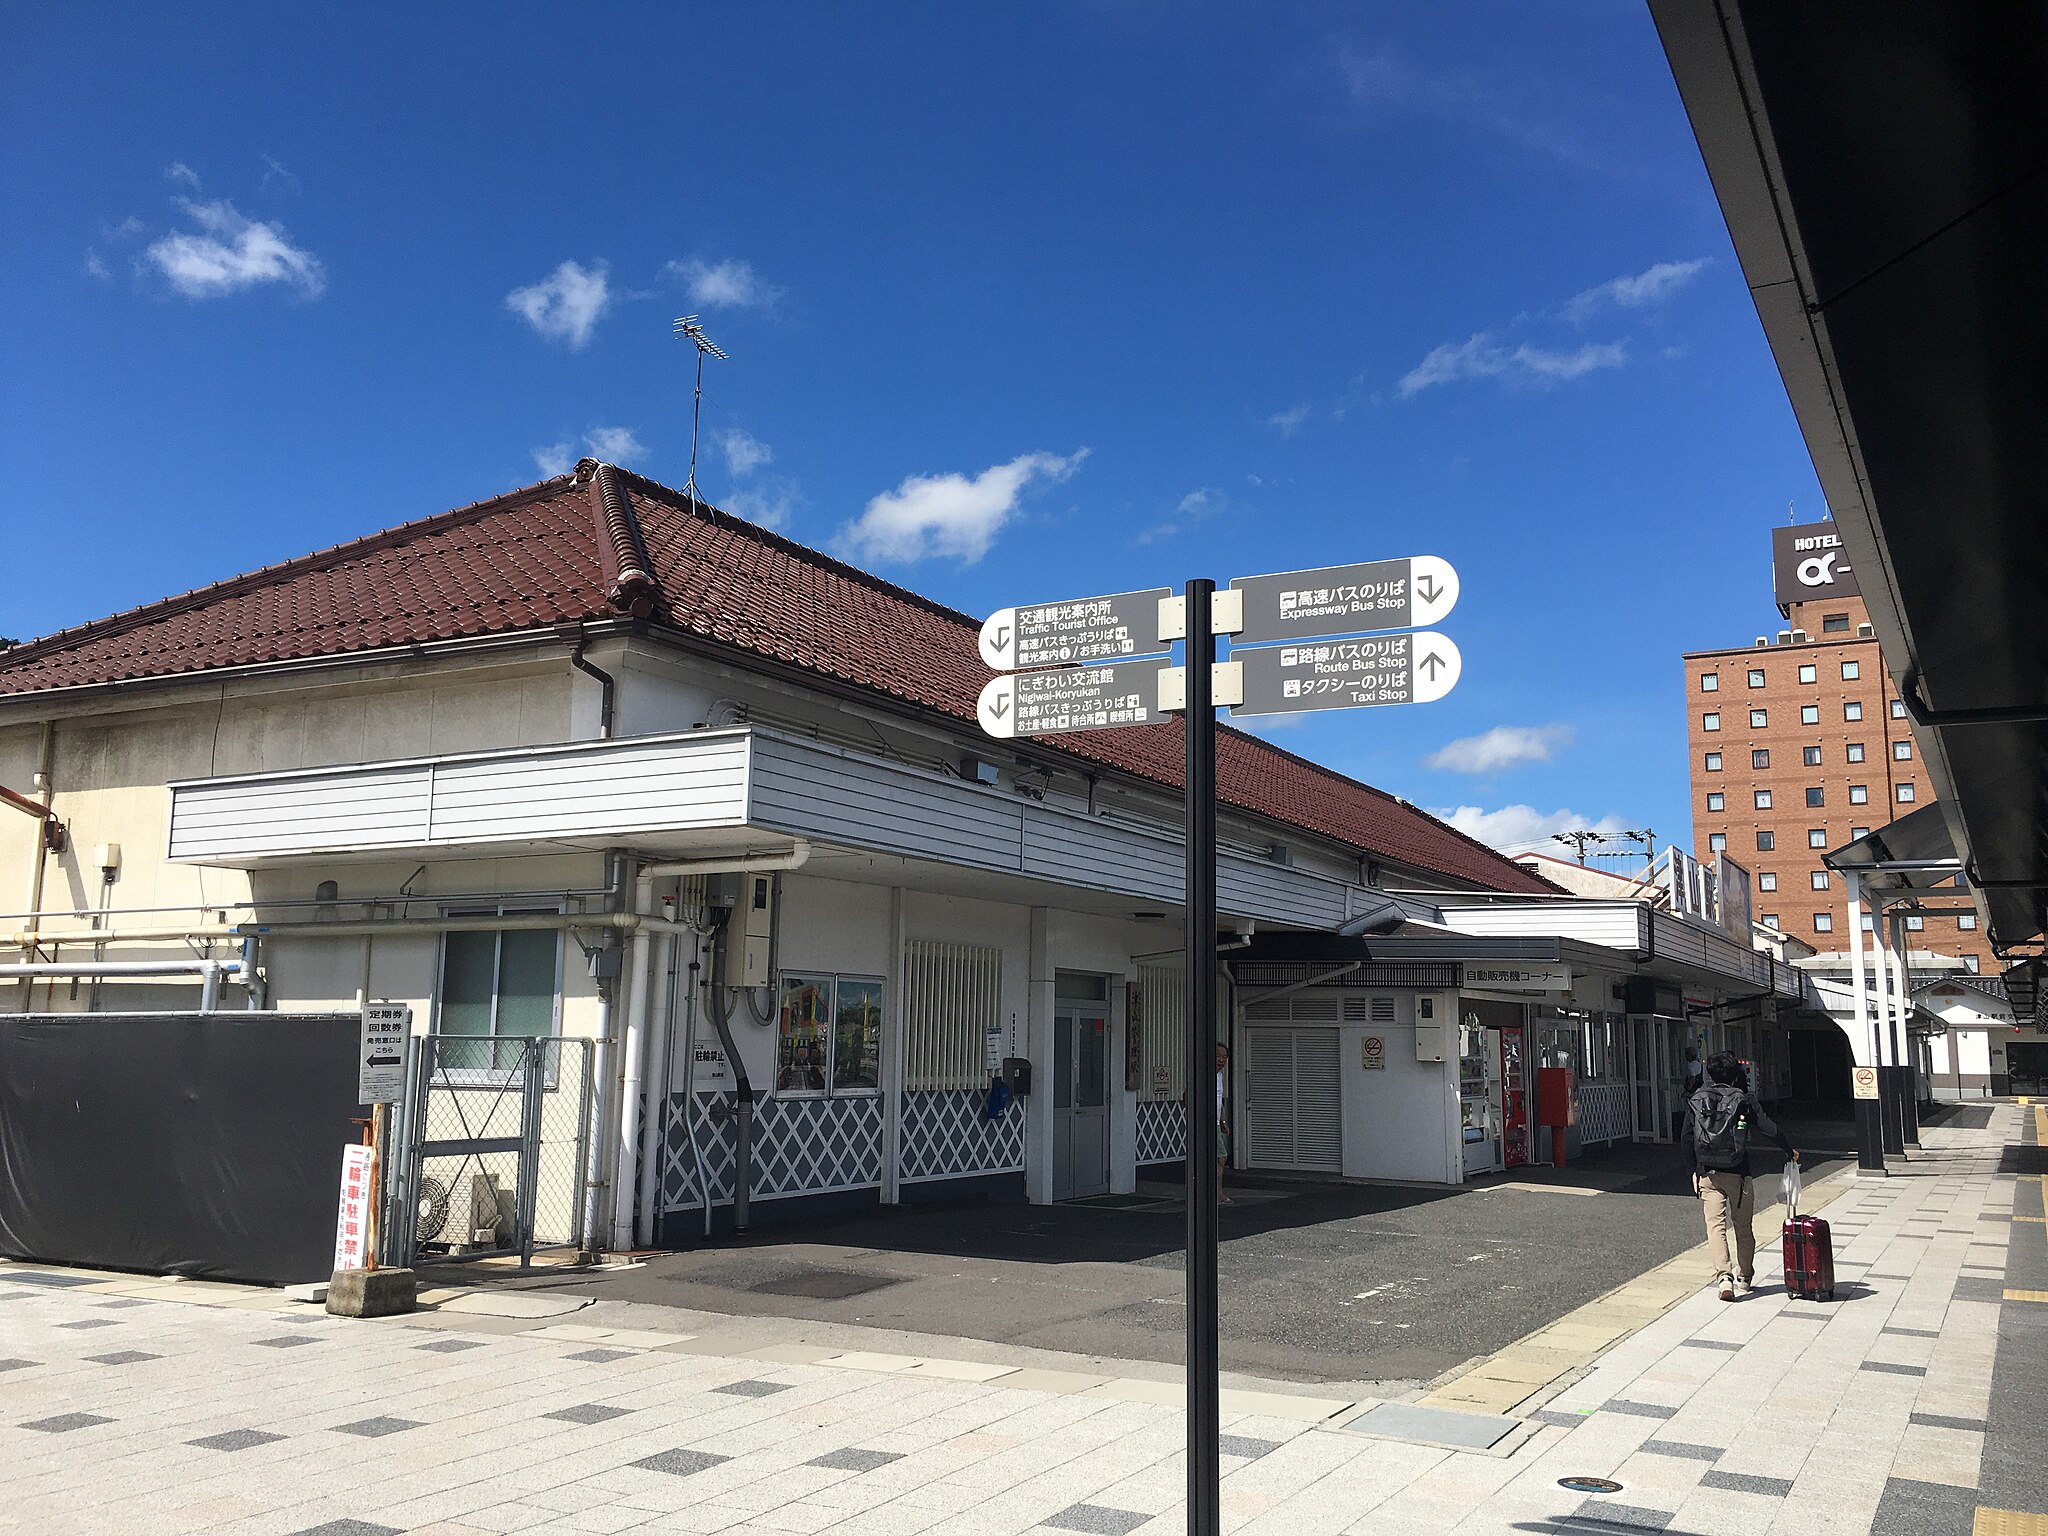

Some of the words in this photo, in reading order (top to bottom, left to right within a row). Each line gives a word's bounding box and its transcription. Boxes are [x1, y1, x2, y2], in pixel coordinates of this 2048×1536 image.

[1795, 534, 1843, 551] HOTEL
[1297, 578, 1406, 607] 高速バスのりば
[1019, 600, 1112, 626] 交通観光案内所
[1279, 604, 1348, 621] Expressway
[1351, 600, 1374, 612] Bus
[1376, 597, 1406, 610] Stop
[1019, 623, 1050, 636] Traffic
[1051, 619, 1086, 632] Tourist
[1088, 615, 1119, 627] Office
[1019, 628, 1115, 652] 高速バスきっぷうりば
[1298, 638, 1408, 665] 路線バスのりば
[1314, 662, 1350, 674] Route
[1352, 660, 1375, 671] Bus
[1378, 656, 1407, 669] Stop
[1018, 668, 1114, 693] にぎわい交流館
[1301, 670, 1408, 695] タクシーのりば
[1018, 687, 1101, 705] Nigiwai-Koryukan
[1350, 691, 1376, 703] Taxi
[1378, 688, 1408, 702] Stop
[1018, 696, 1126, 719] 路線バスきっぷうりば
[1071, 713, 1095, 727] 待合所
[1109, 709, 1134, 723] 喫煙所
[1466, 969, 1564, 983] 自動販売機コーナー
[369, 1010, 403, 1019] 定期券
[368, 1022, 402, 1032] 回数券
[366, 1037, 402, 1045] 発売窓口は
[375, 1046, 394, 1054] こちら
[695, 1050, 725, 1062] 駐輪禁止
[344, 1150, 364, 1271] 二輪車駐車禁止
